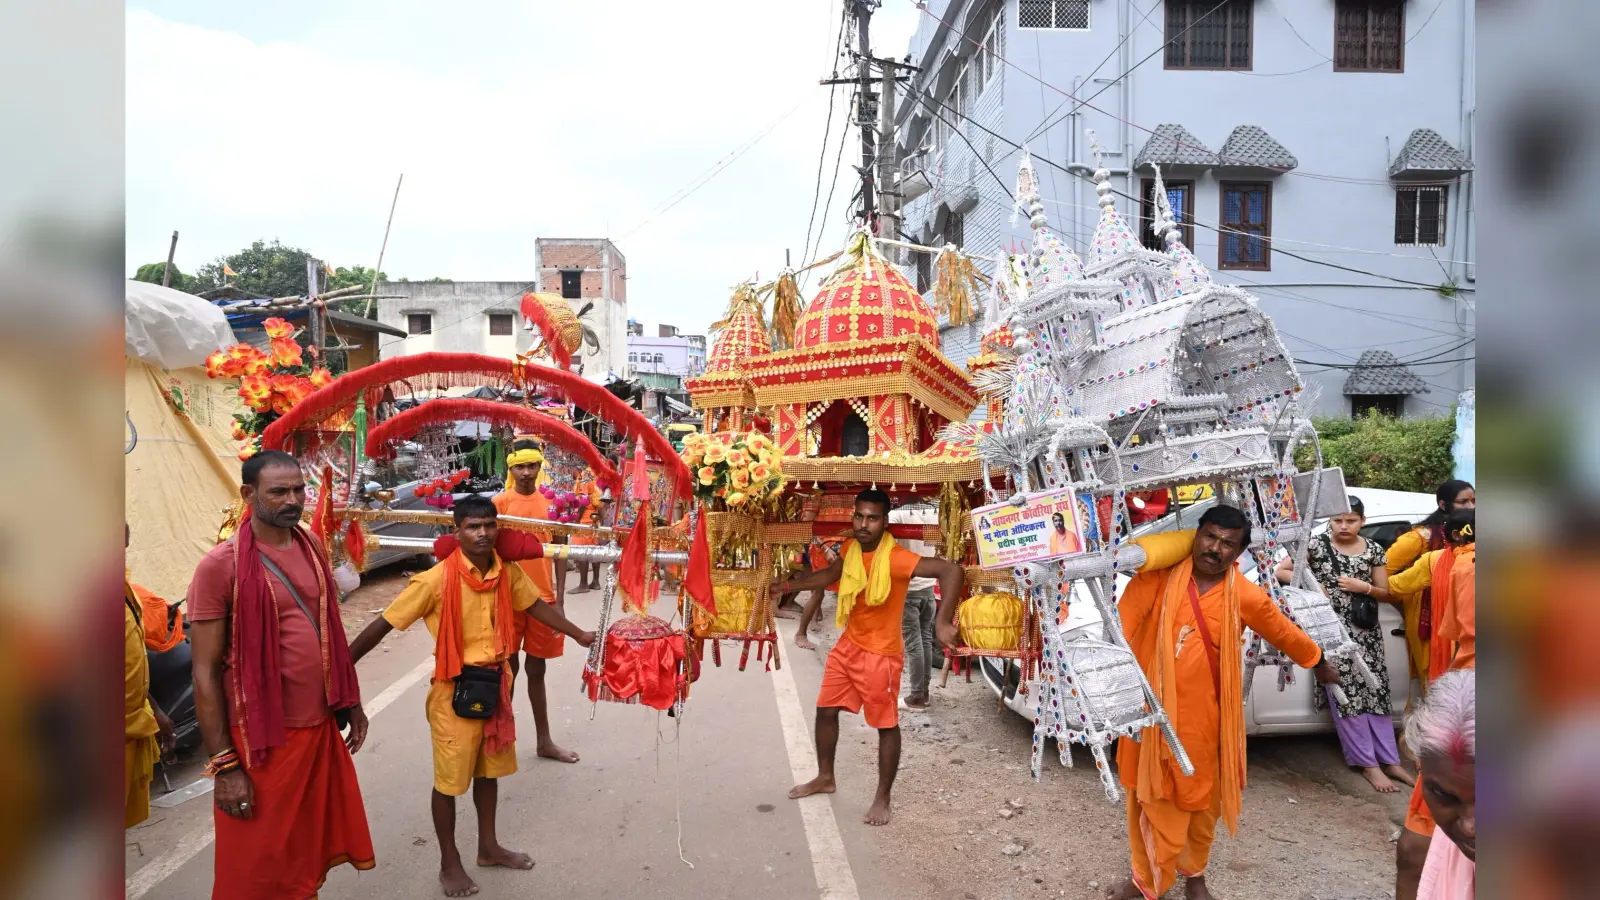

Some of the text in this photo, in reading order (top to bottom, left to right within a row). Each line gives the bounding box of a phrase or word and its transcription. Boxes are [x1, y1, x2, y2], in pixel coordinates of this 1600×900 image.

[983, 533, 993, 542] न्यू
[1012, 521, 1046, 535] ऑप्टिकल्स
[998, 535, 1037, 548] प्रदीप कुमार
